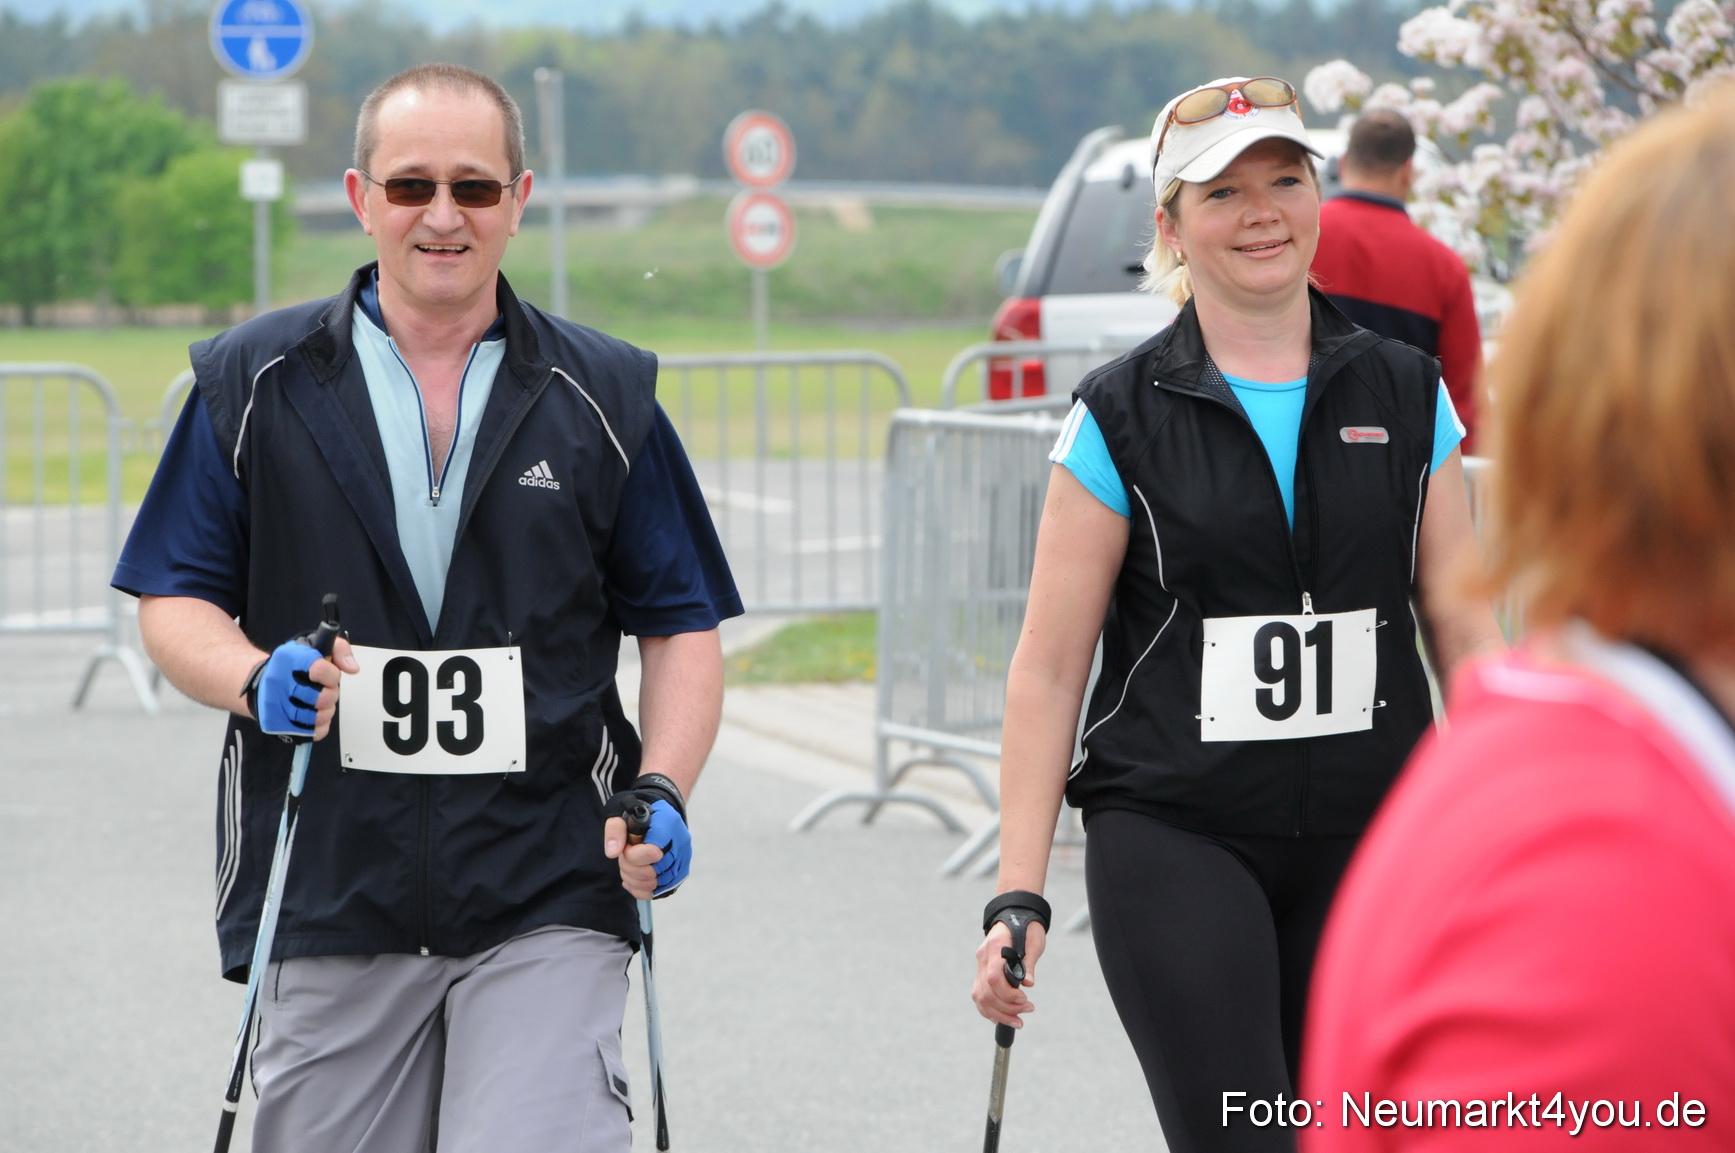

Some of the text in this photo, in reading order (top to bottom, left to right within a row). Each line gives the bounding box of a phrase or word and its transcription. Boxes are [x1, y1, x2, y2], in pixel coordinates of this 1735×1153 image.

[518, 476, 560, 490] adidas
[382, 655, 484, 756] 93
[1253, 620, 1333, 721] 91
